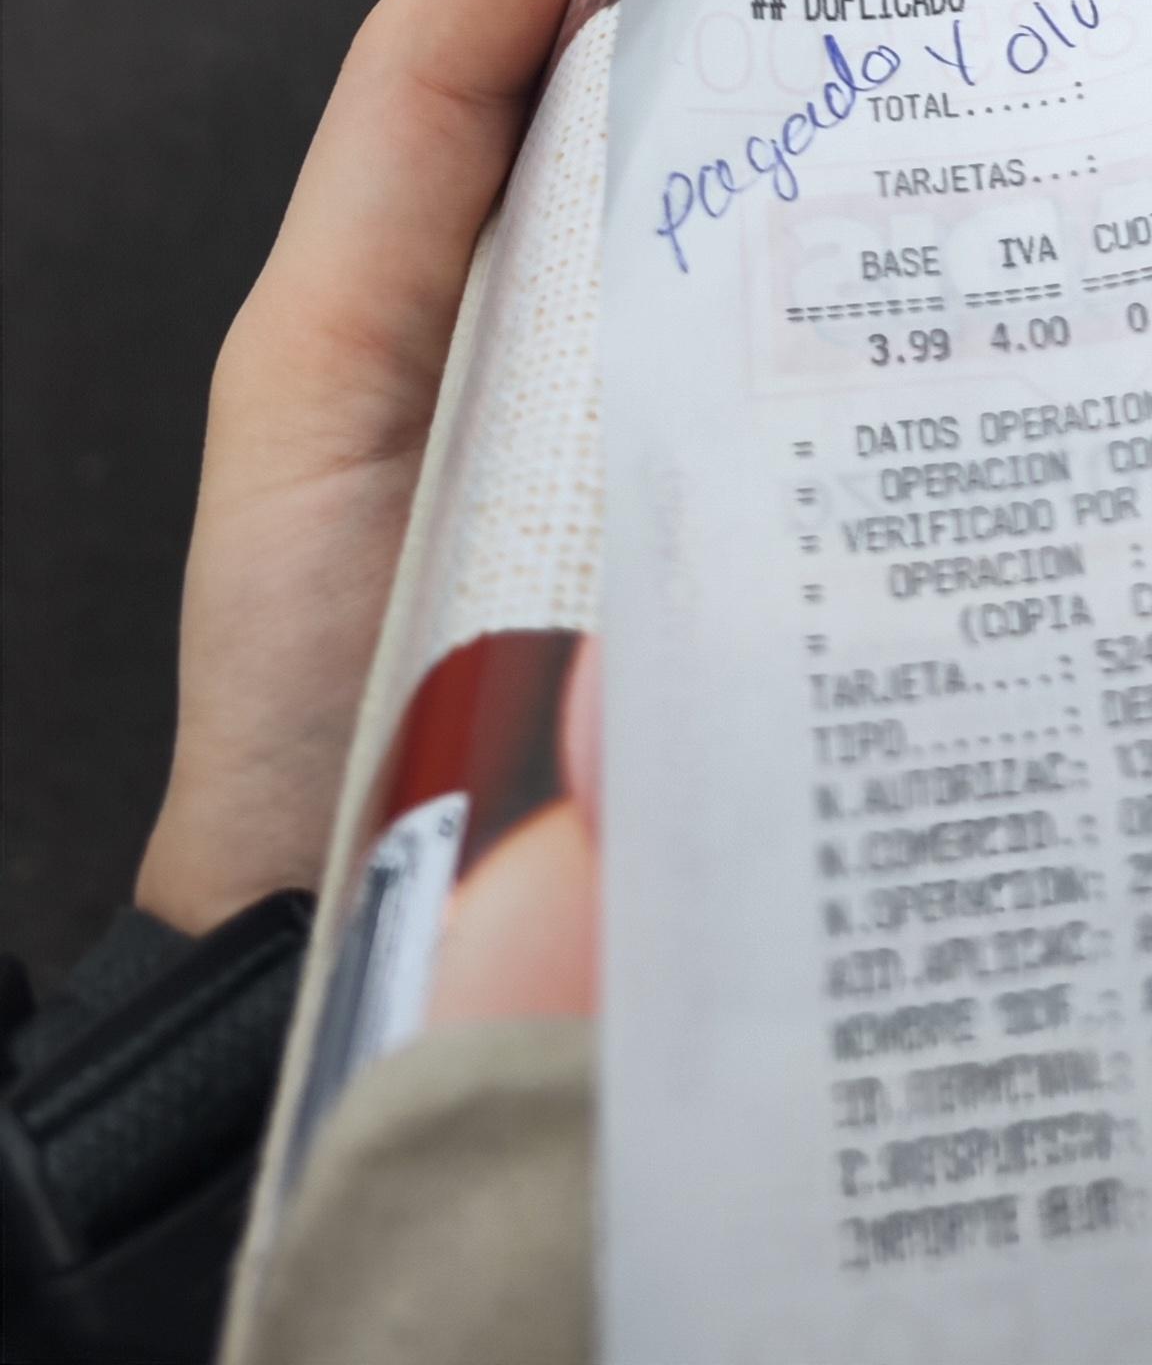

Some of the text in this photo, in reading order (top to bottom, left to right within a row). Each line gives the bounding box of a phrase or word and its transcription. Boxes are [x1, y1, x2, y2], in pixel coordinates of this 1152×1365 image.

[861, 245, 941, 282] BASE
[999, 234, 1059, 270] IVA
[868, 327, 953, 368] 3.99
[990, 315, 1072, 355] 4.00
[857, 416, 960, 457] DATOS
[880, 449, 1072, 504] OPERACION
[841, 498, 1055, 556] VERIFICADO
[1075, 485, 1141, 527] POR
[888, 545, 1086, 600] OPERACION
[959, 593, 1096, 648] (COPIA
